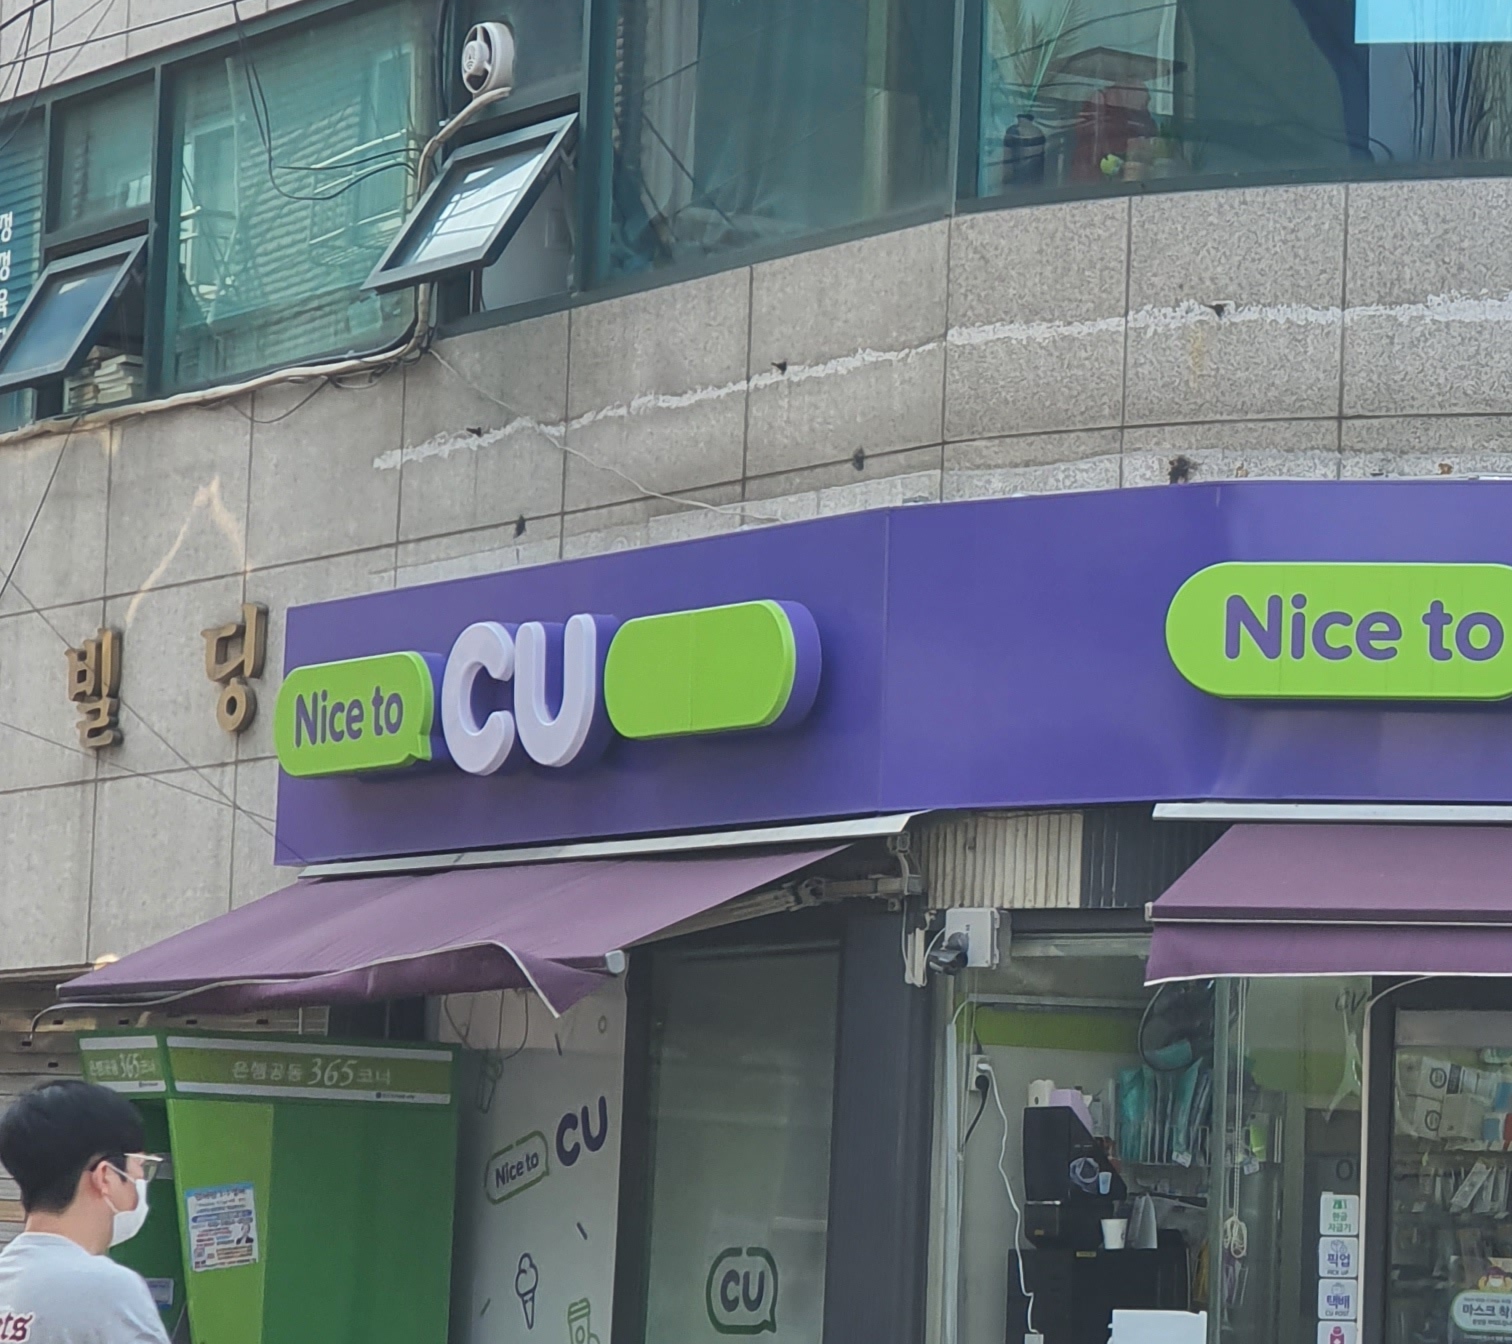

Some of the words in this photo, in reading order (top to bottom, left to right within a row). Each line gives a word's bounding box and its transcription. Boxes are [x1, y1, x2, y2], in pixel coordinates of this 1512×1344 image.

[1223, 592, 1403, 662] Nice
[1421, 599, 1505, 662] to
[295, 689, 364, 750] Nice
[371, 685, 404, 736] to
[441, 613, 598, 776] CU
[495, 1161, 524, 1189] Nice
[525, 1152, 539, 1172] to
[556, 1095, 609, 1167] CU
[1327, 1253, 1351, 1268] 픽업
[720, 1269, 765, 1312] CU
[1326, 1294, 1351, 1310] 택배
[1462, 1303, 1496, 1317] 마스크
